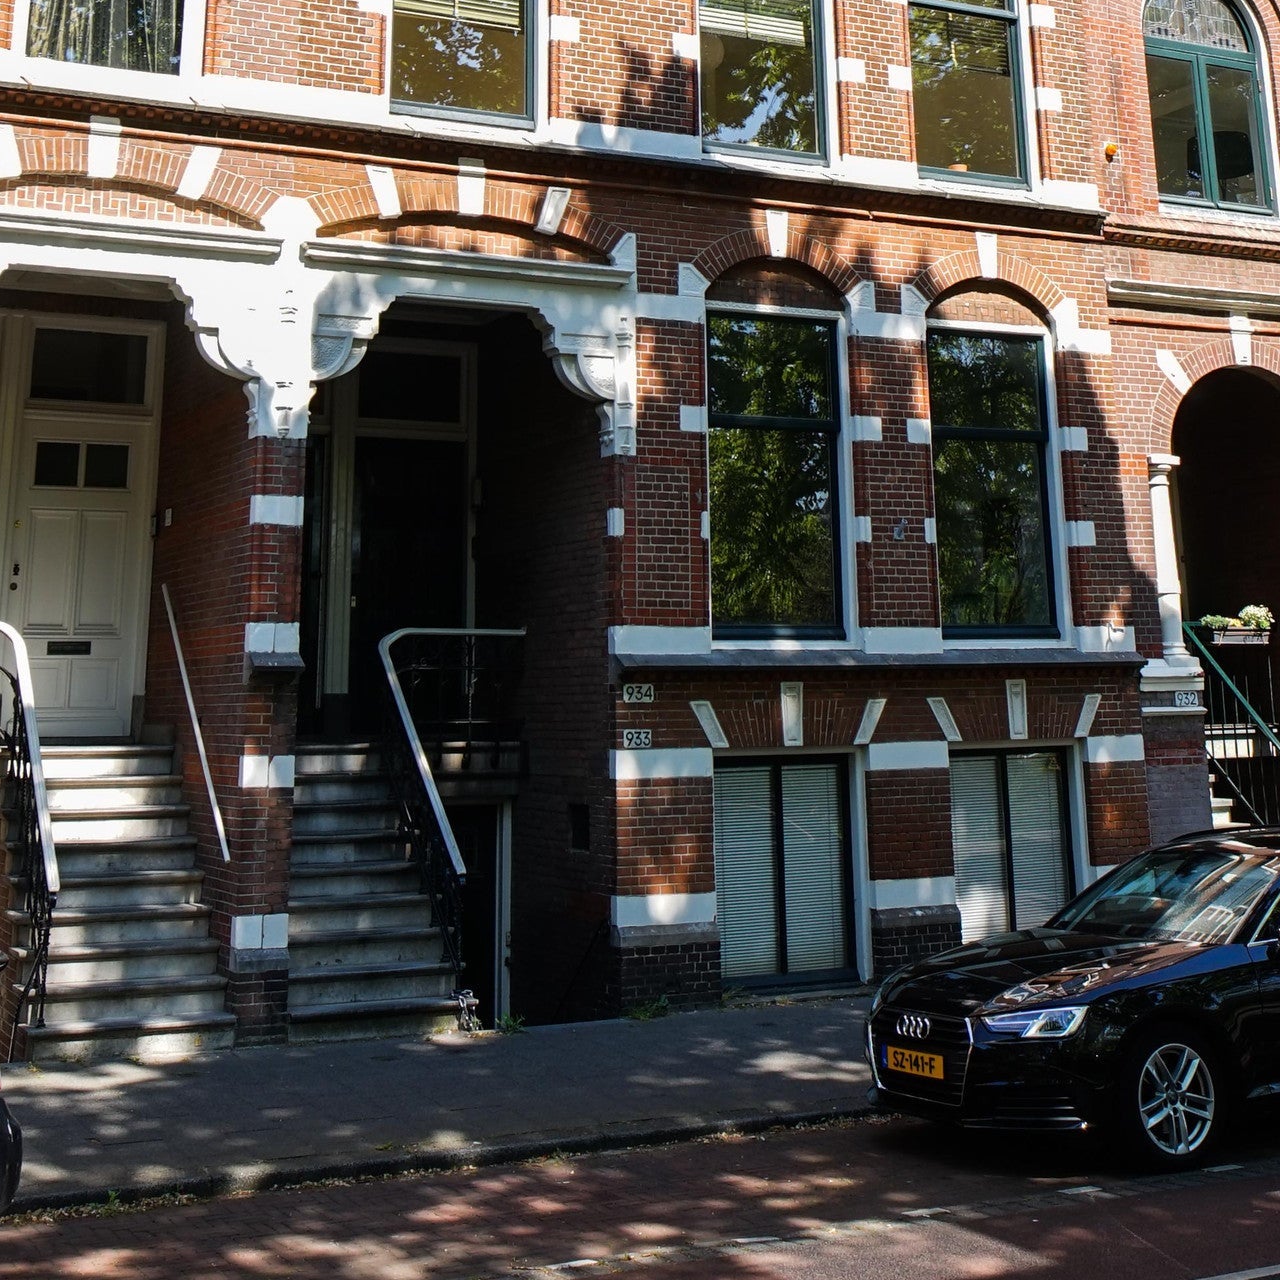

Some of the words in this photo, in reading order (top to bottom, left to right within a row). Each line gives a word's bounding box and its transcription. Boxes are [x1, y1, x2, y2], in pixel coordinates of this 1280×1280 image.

[626, 685, 652, 701] 934
[1177, 692, 1197, 706] 932
[625, 731, 650, 747] 933
[892, 1050, 936, 1074] SZ-141-F
